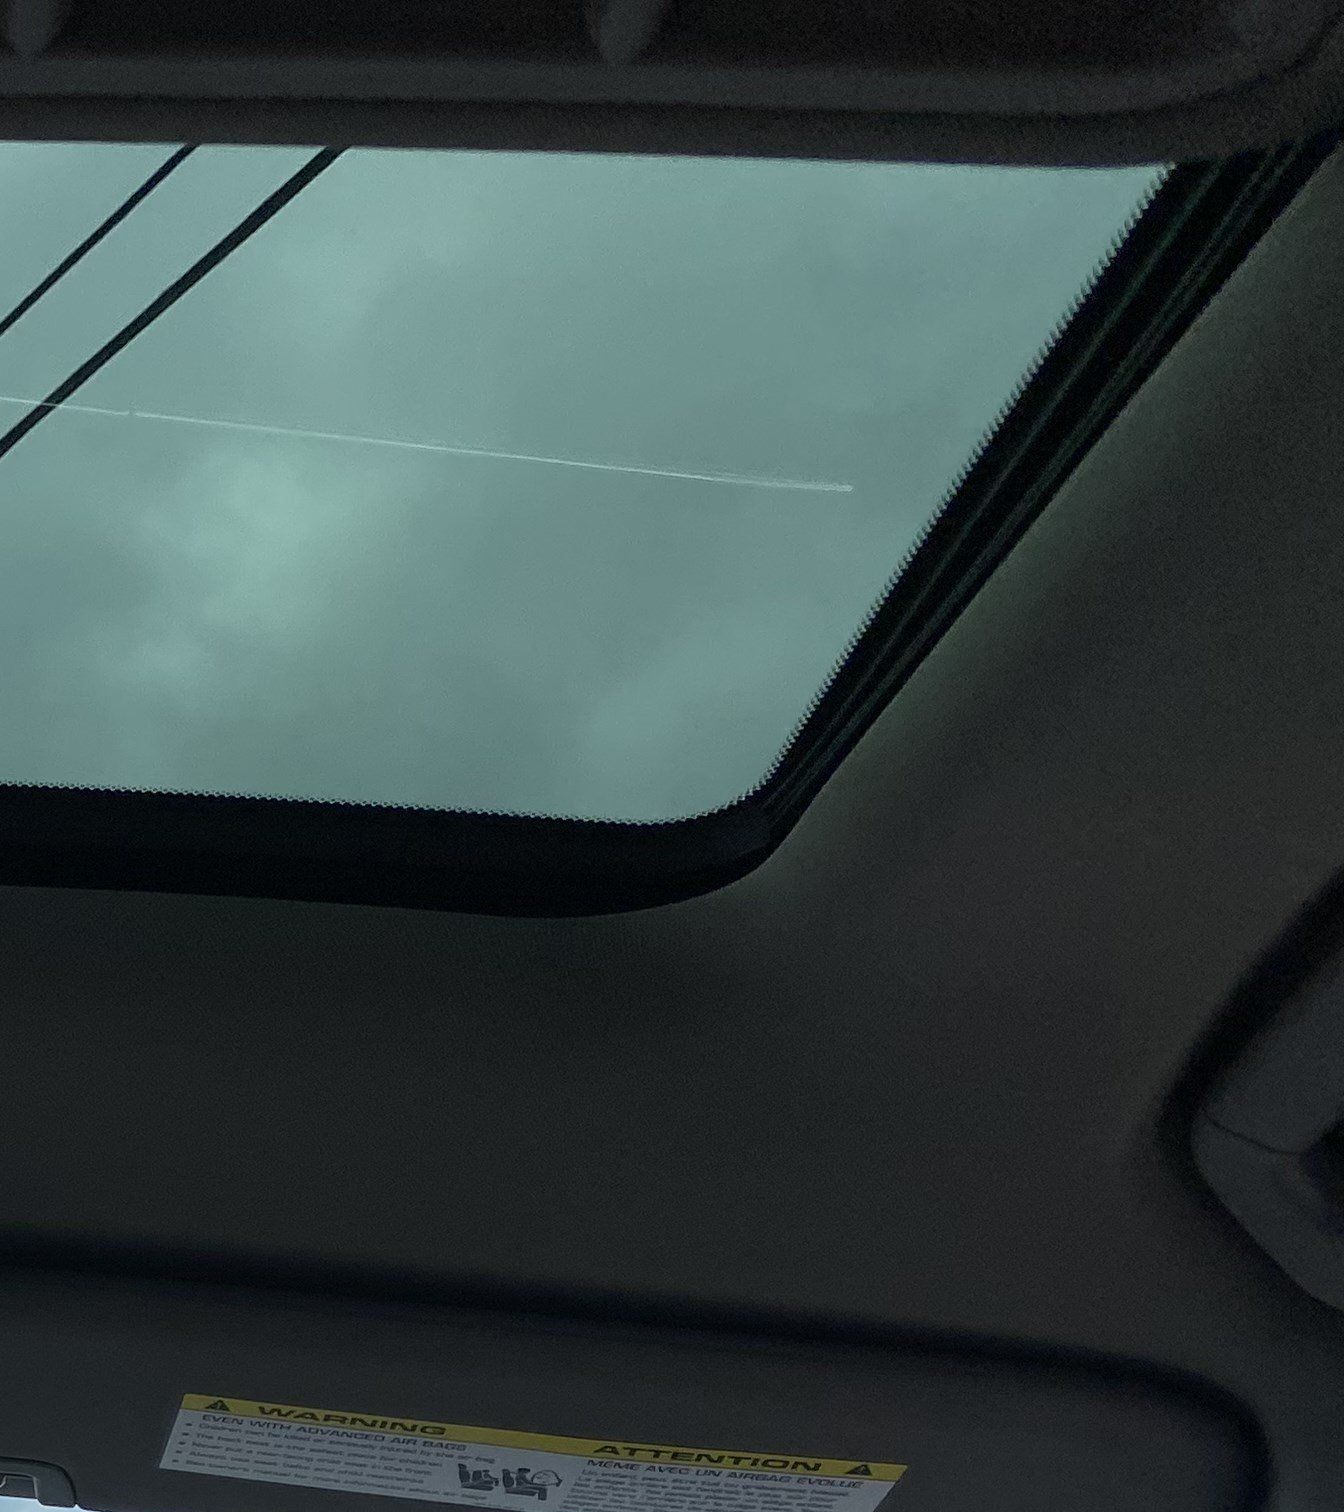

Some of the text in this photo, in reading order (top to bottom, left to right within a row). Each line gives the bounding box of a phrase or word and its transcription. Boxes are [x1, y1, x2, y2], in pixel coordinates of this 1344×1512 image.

[202, 1414, 243, 1426] EVEN
[249, 1419, 292, 1431] WITH
[297, 1425, 387, 1442] ADVANCED
[258, 1406, 446, 1436] WARNING
[593, 1445, 822, 1472] ATTENTION
